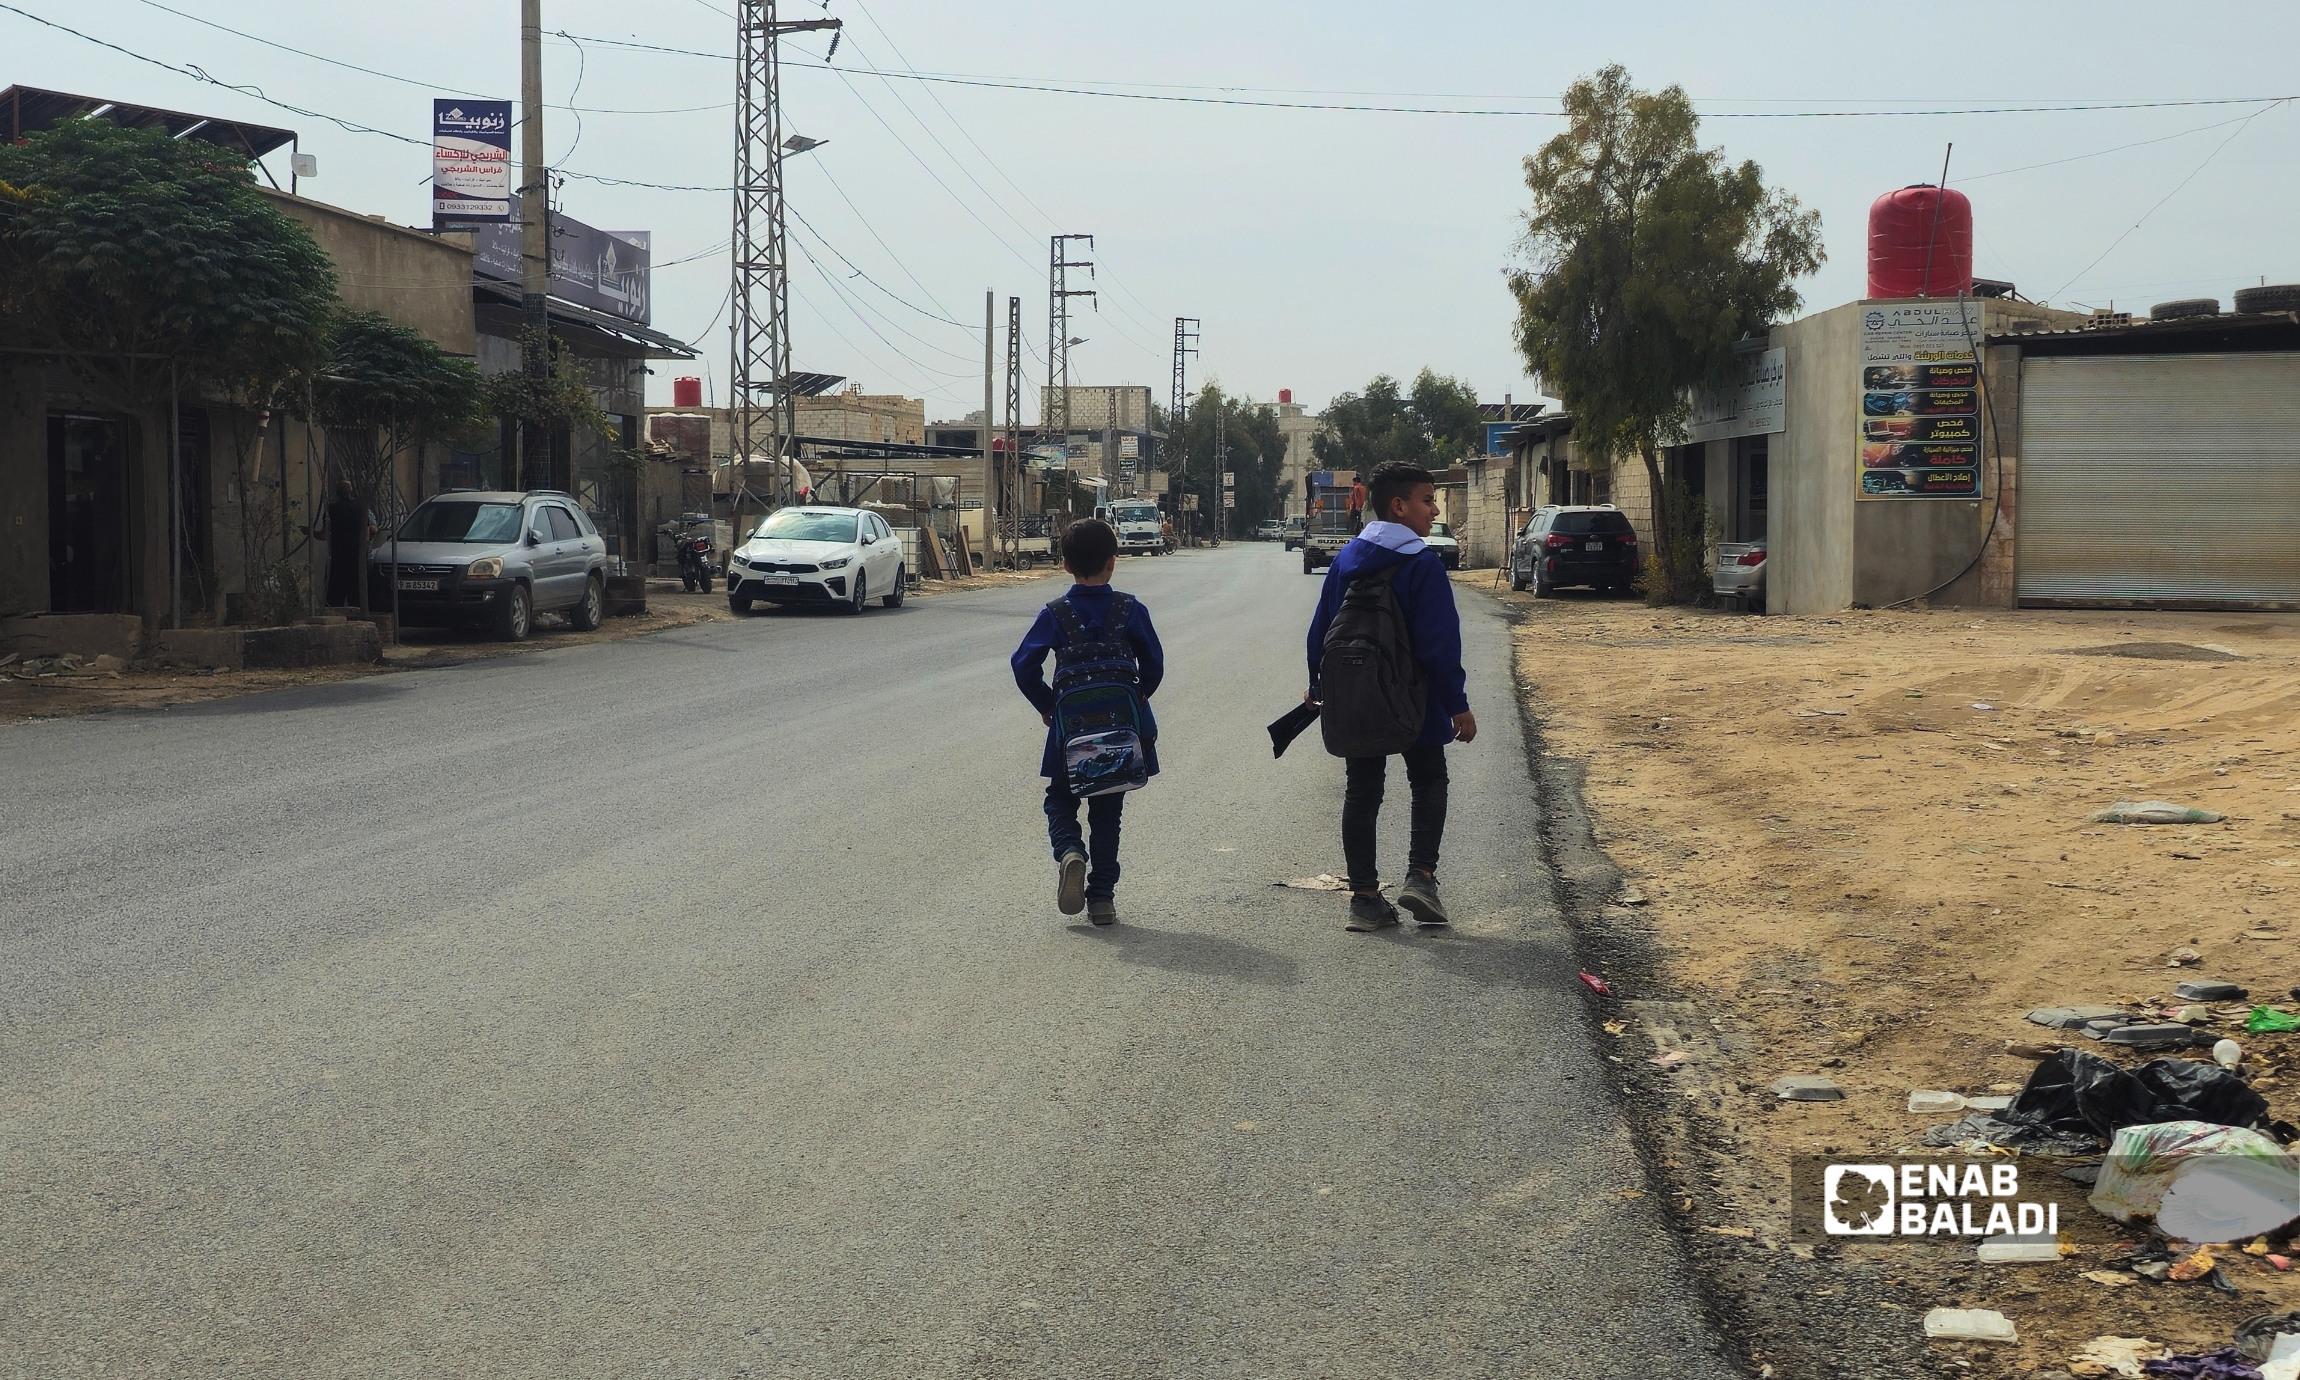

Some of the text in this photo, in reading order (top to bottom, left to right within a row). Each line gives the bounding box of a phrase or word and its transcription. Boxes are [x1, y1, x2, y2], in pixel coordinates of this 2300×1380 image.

[439, 111, 505, 130] زنوبيا
[471, 148, 508, 164] الشربجي
[441, 165, 503, 174] فراس الشربجي
[598, 254, 645, 320] زنوبيا
[1893, 308, 1973, 316] ABDULHAY
[1888, 316, 1938, 329] الحي
[1915, 330, 1939, 338] سيارات
[1867, 353, 1890, 361] تشمل
[1914, 350, 1944, 362] الورشة
[1946, 350, 1975, 361] خدمات
[1770, 359, 1783, 388] مركز
[1929, 367, 1953, 375] وصيانة
[1931, 377, 1972, 386] المحركات
[1937, 419, 1963, 427] فحص
[1929, 429, 1970, 438] كمبيوتر
[1929, 455, 1966, 465] كاملة
[1953, 473, 1971, 482] إصلاح
